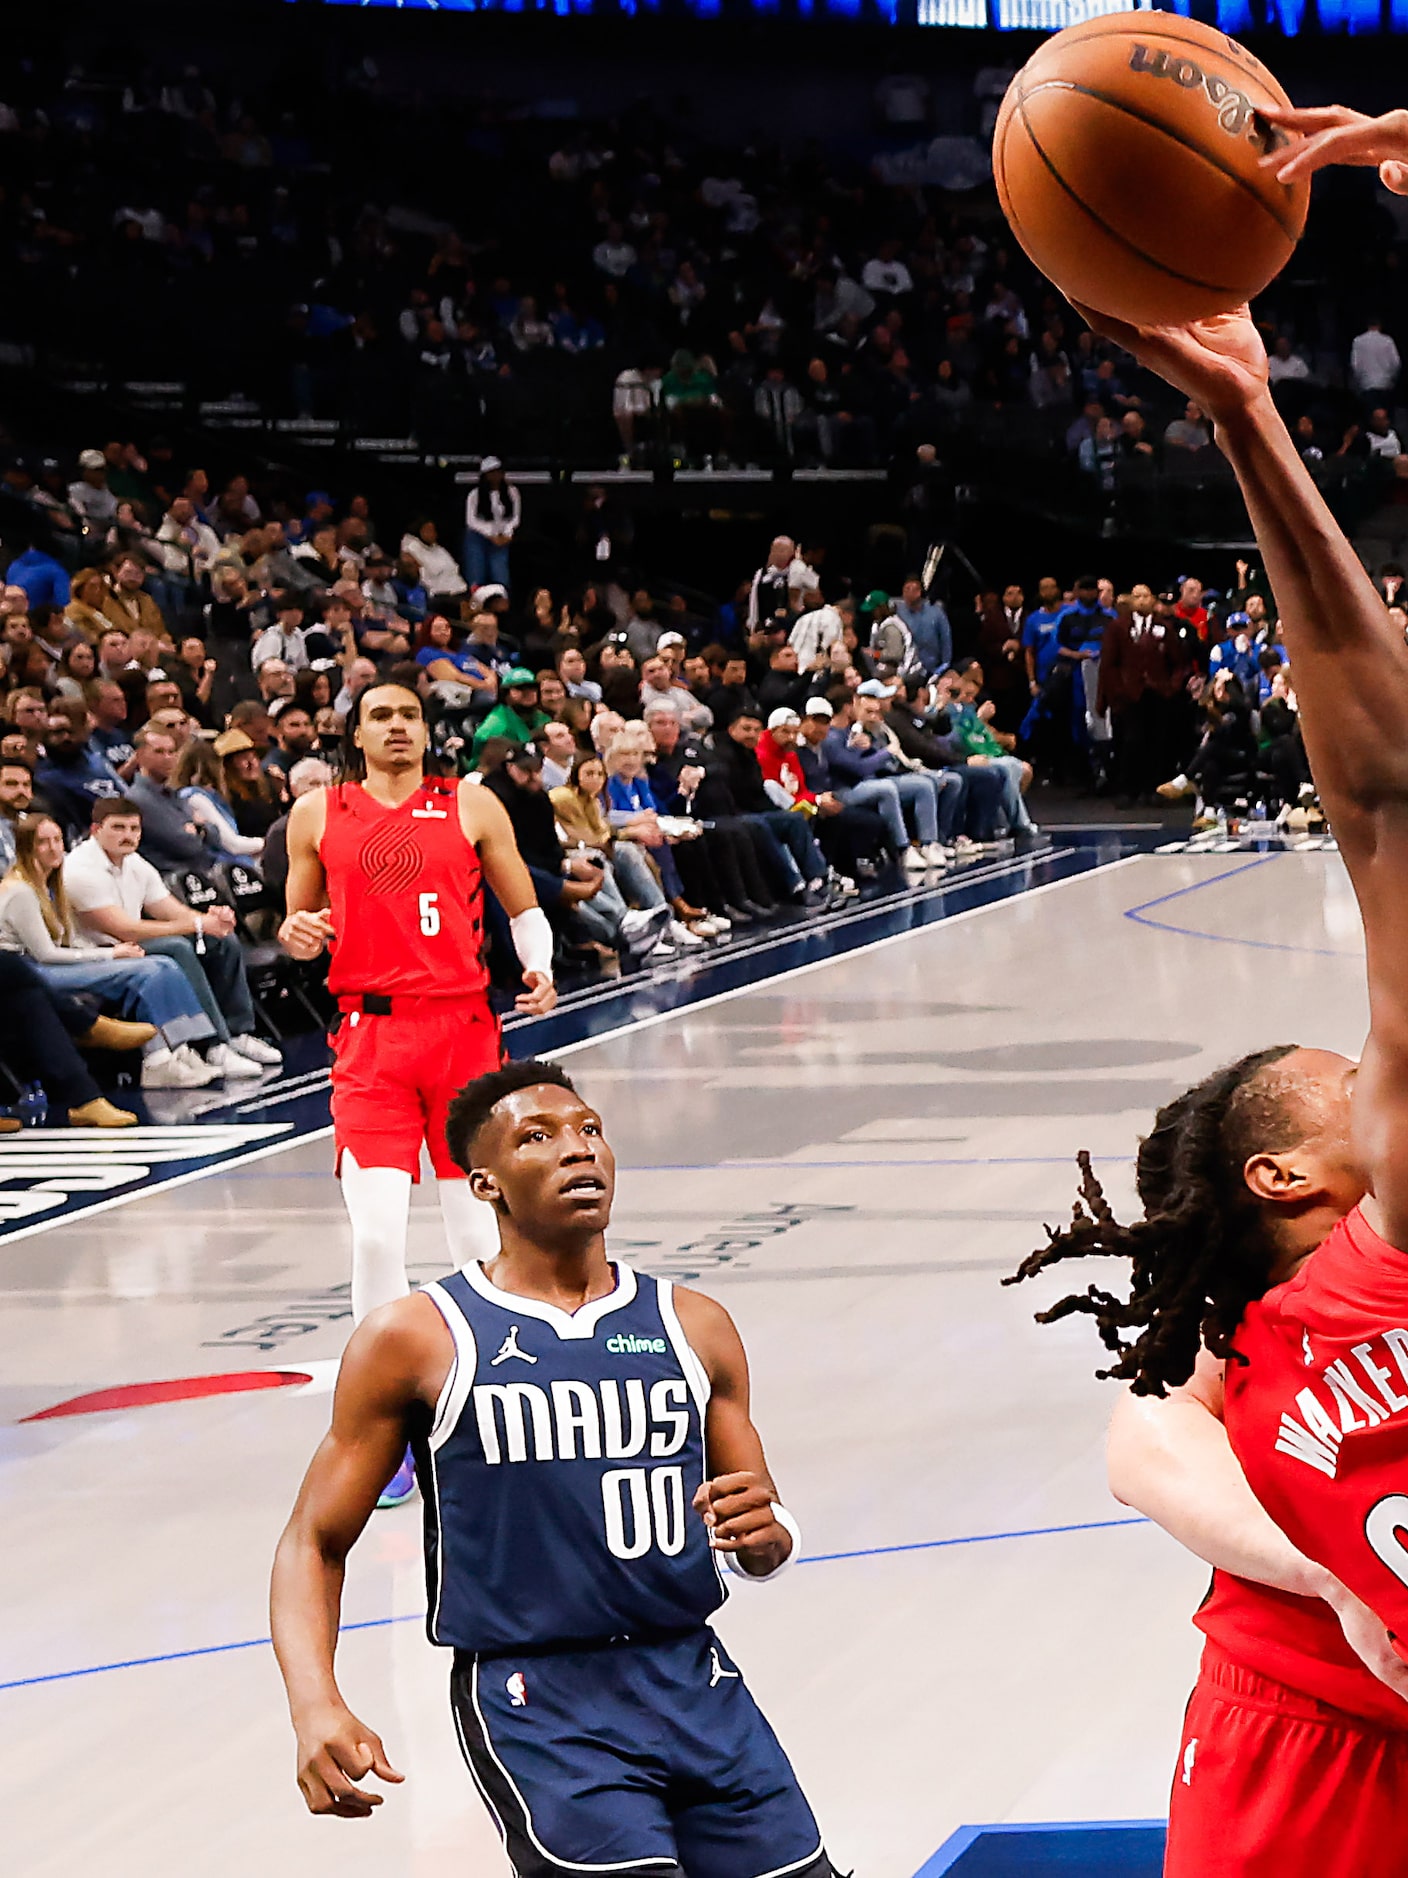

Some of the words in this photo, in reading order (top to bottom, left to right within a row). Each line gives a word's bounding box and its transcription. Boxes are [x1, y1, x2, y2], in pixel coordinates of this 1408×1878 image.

[418, 892, 441, 937] 5
[606, 1333, 667, 1354] chime
[472, 1378, 690, 1466] MAVS
[601, 1465, 687, 1561] 00
